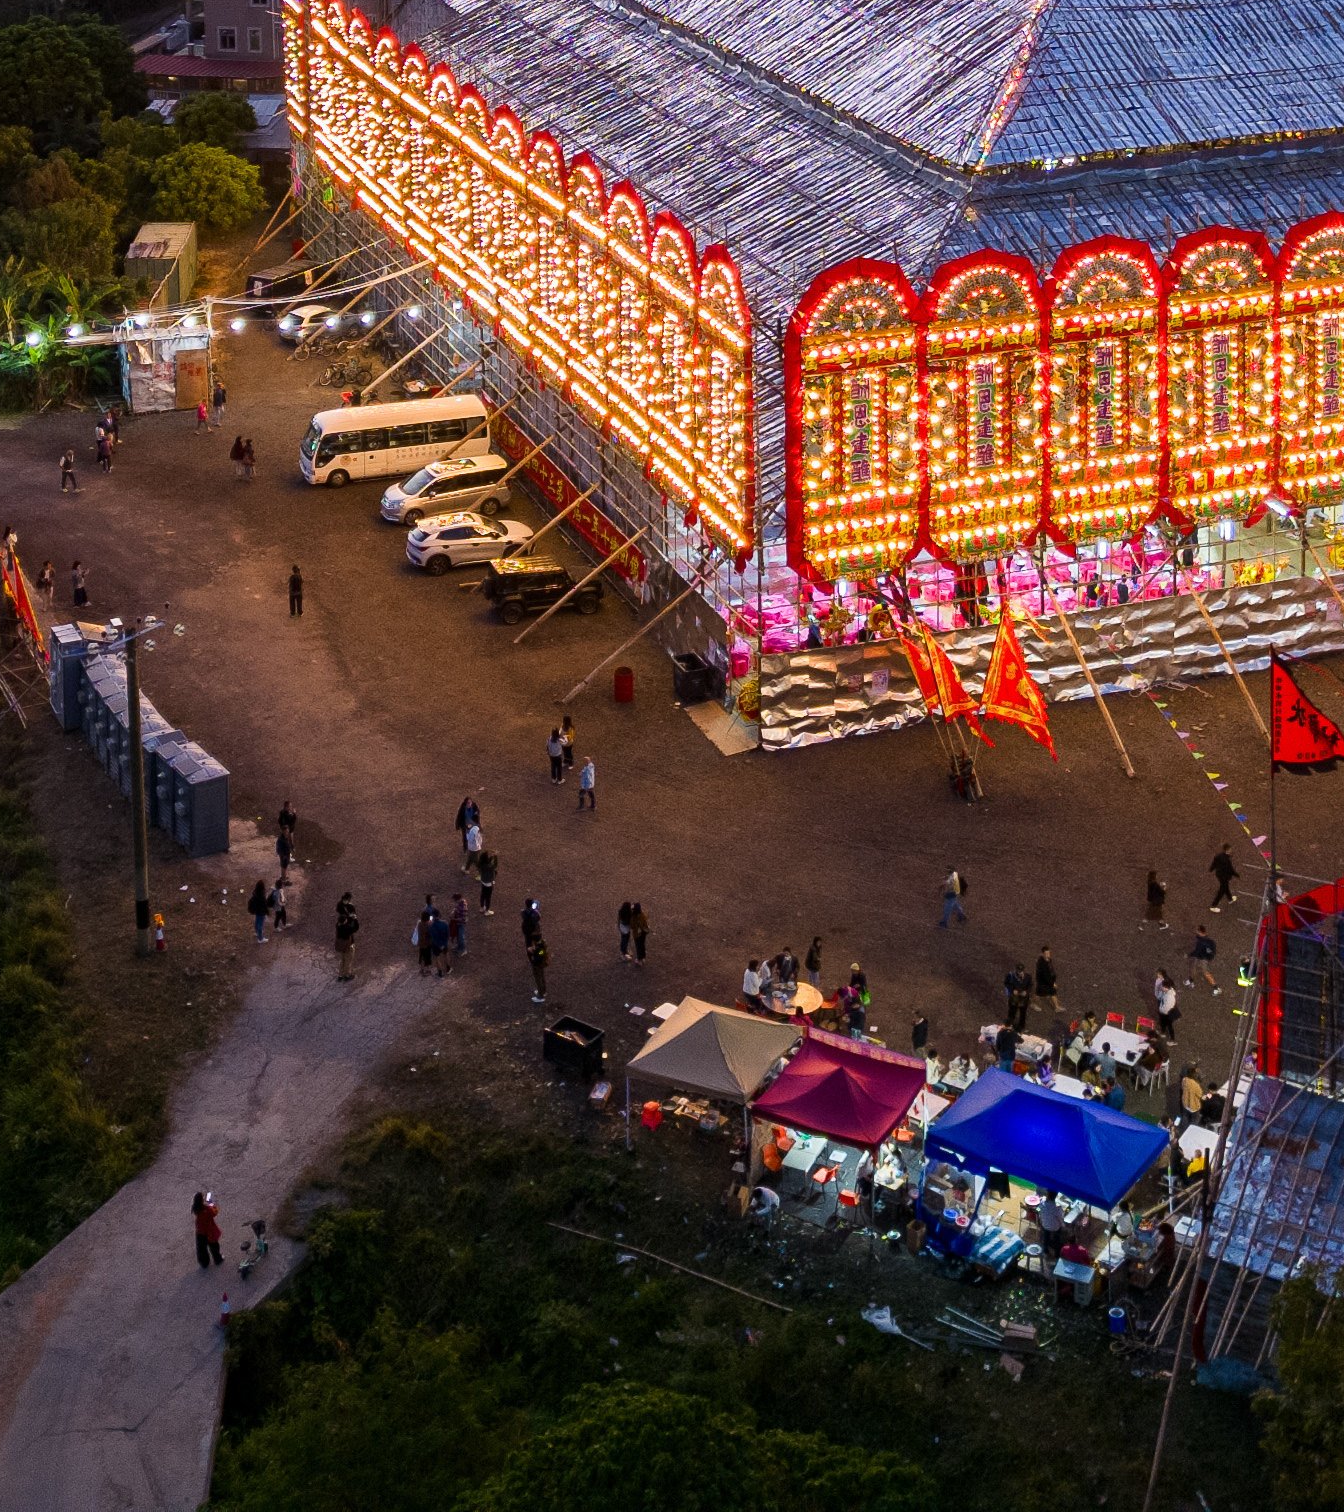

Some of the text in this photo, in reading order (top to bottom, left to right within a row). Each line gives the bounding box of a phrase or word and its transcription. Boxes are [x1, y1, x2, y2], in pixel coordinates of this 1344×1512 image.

[974, 362, 995, 468] 酬恩建醮
[1095, 344, 1113, 447] 酬恩建醮
[1212, 334, 1230, 434] 酬恩建醮
[1323, 316, 1340, 416] 酬恩建醮
[850, 377, 870, 484] 酬恩建醮
